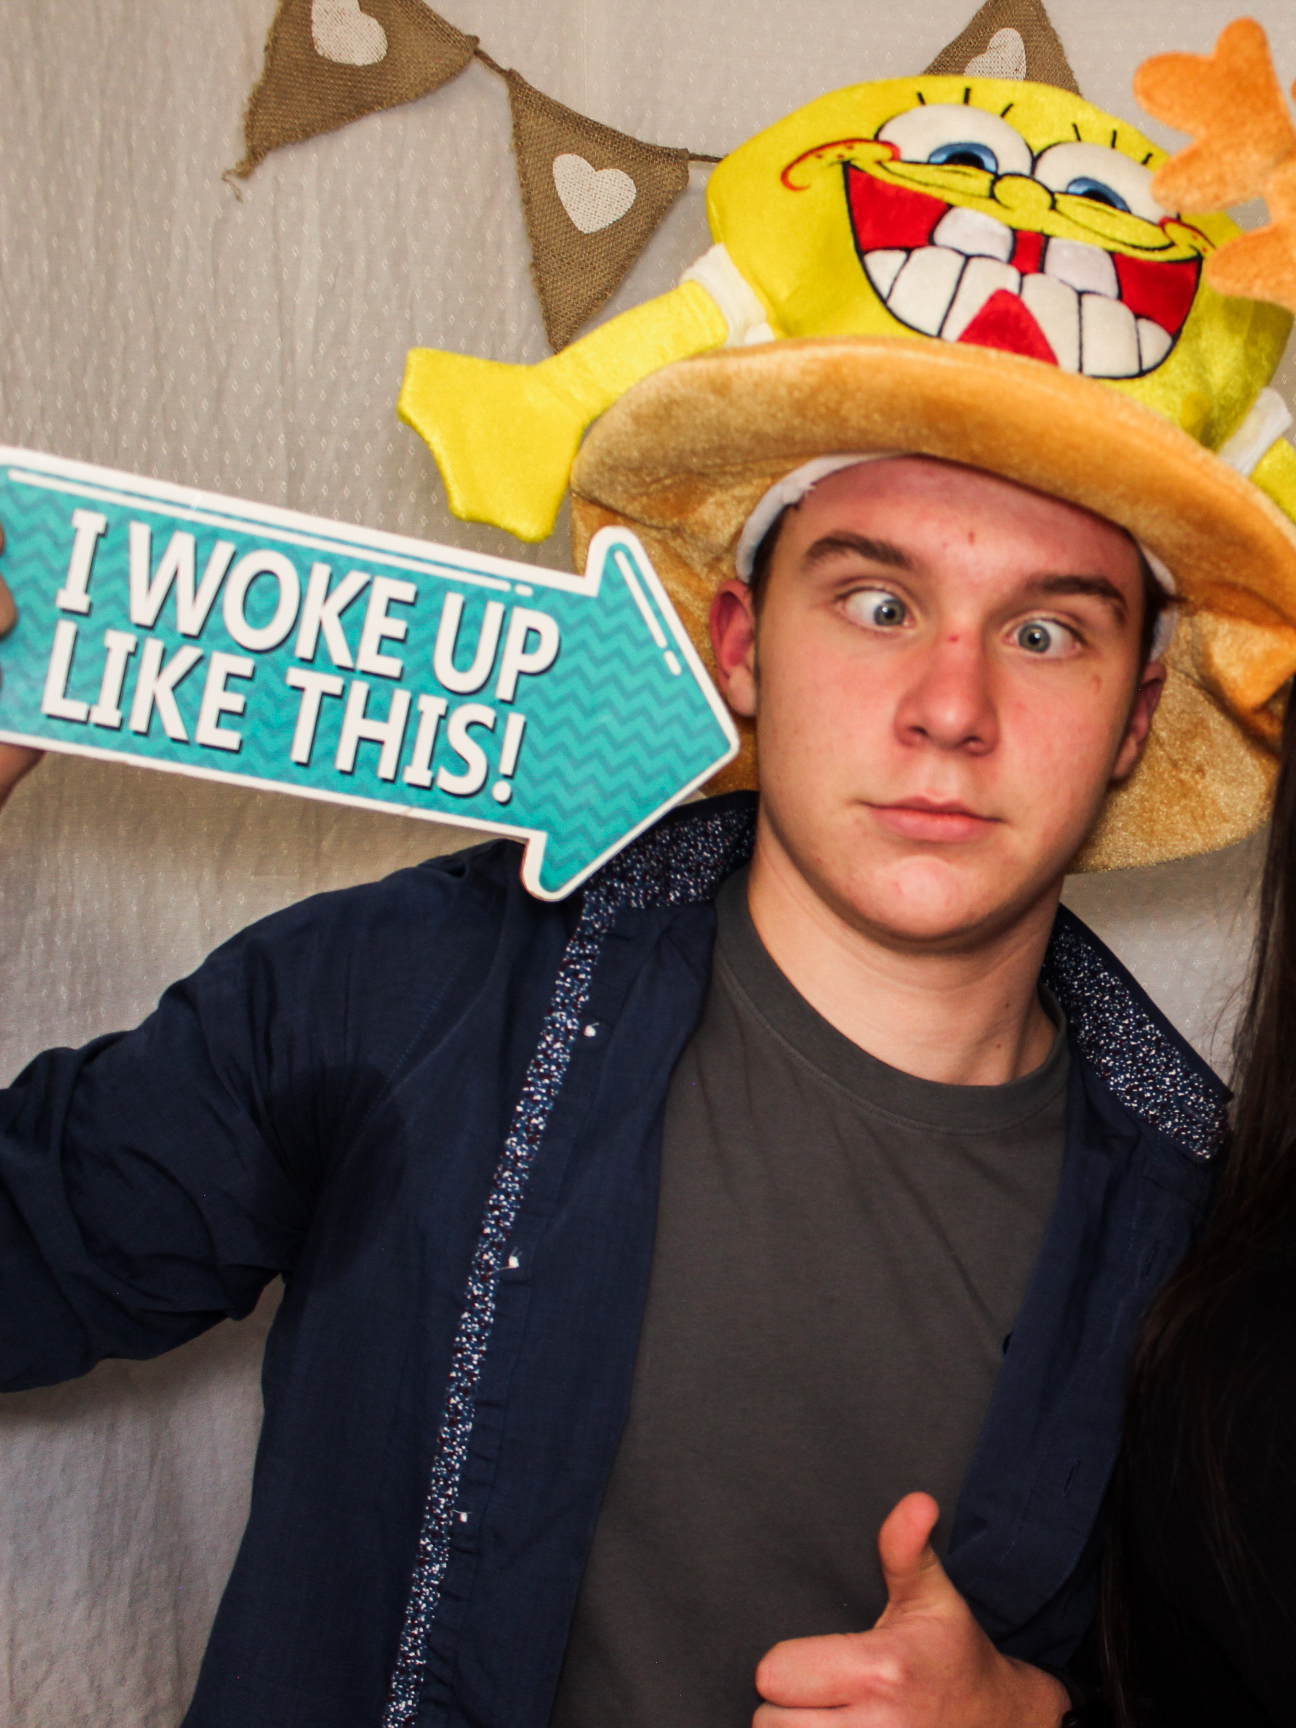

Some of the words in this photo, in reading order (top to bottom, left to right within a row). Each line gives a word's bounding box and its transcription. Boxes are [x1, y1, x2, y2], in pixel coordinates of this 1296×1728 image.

[55, 508, 108, 613] I
[128, 520, 418, 678] WOKE
[433, 591, 561, 701] UP
[40, 619, 255, 751] LIKE
[285, 667, 527, 803] THIS!
